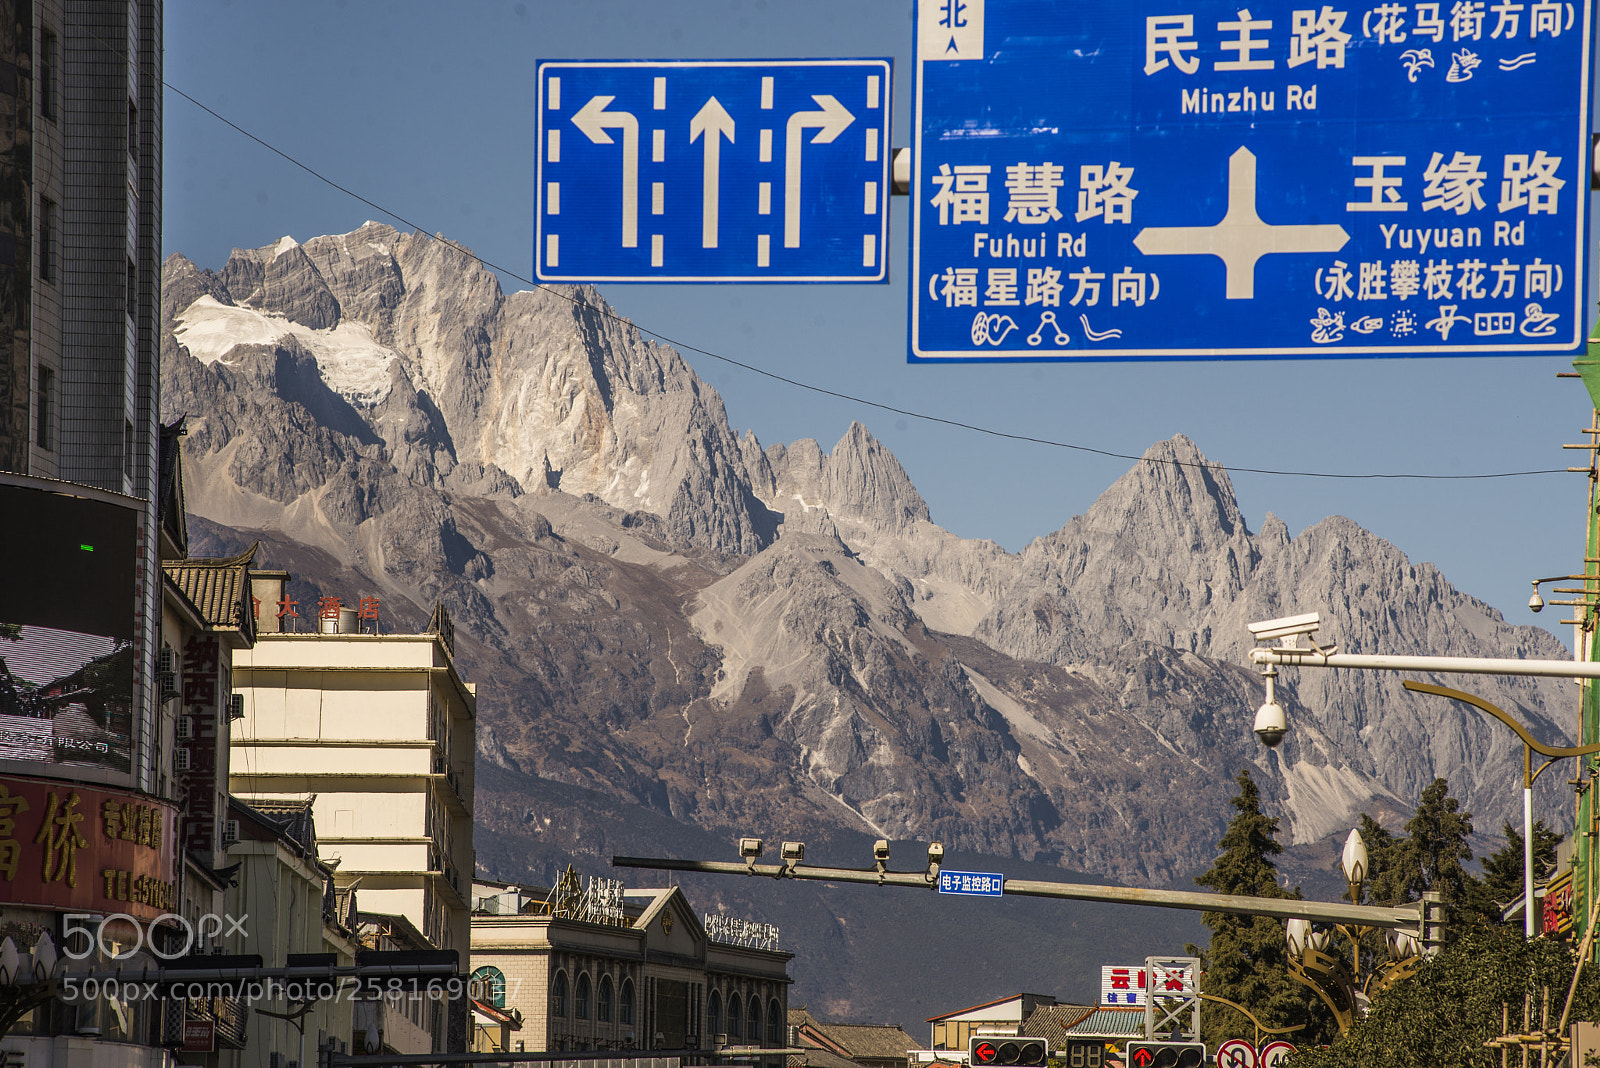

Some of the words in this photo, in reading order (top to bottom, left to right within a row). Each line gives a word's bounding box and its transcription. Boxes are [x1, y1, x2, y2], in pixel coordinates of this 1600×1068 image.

[939, 0, 967, 28] 北
[1362, 1, 1575, 45] (花马街方向)
[1143, 6, 1352, 77] 民主路
[1181, 86, 1275, 115] Minzhu
[1286, 85, 1317, 110] Rd
[930, 161, 1139, 226] 福慧路
[1346, 150, 1566, 216] 玉缘路
[974, 232, 1046, 258] Fuhui
[1057, 232, 1087, 258] Rd
[1379, 222, 1482, 255] Yuyuan
[1494, 220, 1525, 247] Rd
[928, 266, 1160, 308] (福星路方向)
[1314, 257, 1563, 302] (永胜攀枝花方向)
[942, 874, 1000, 893] 电子监控路口
